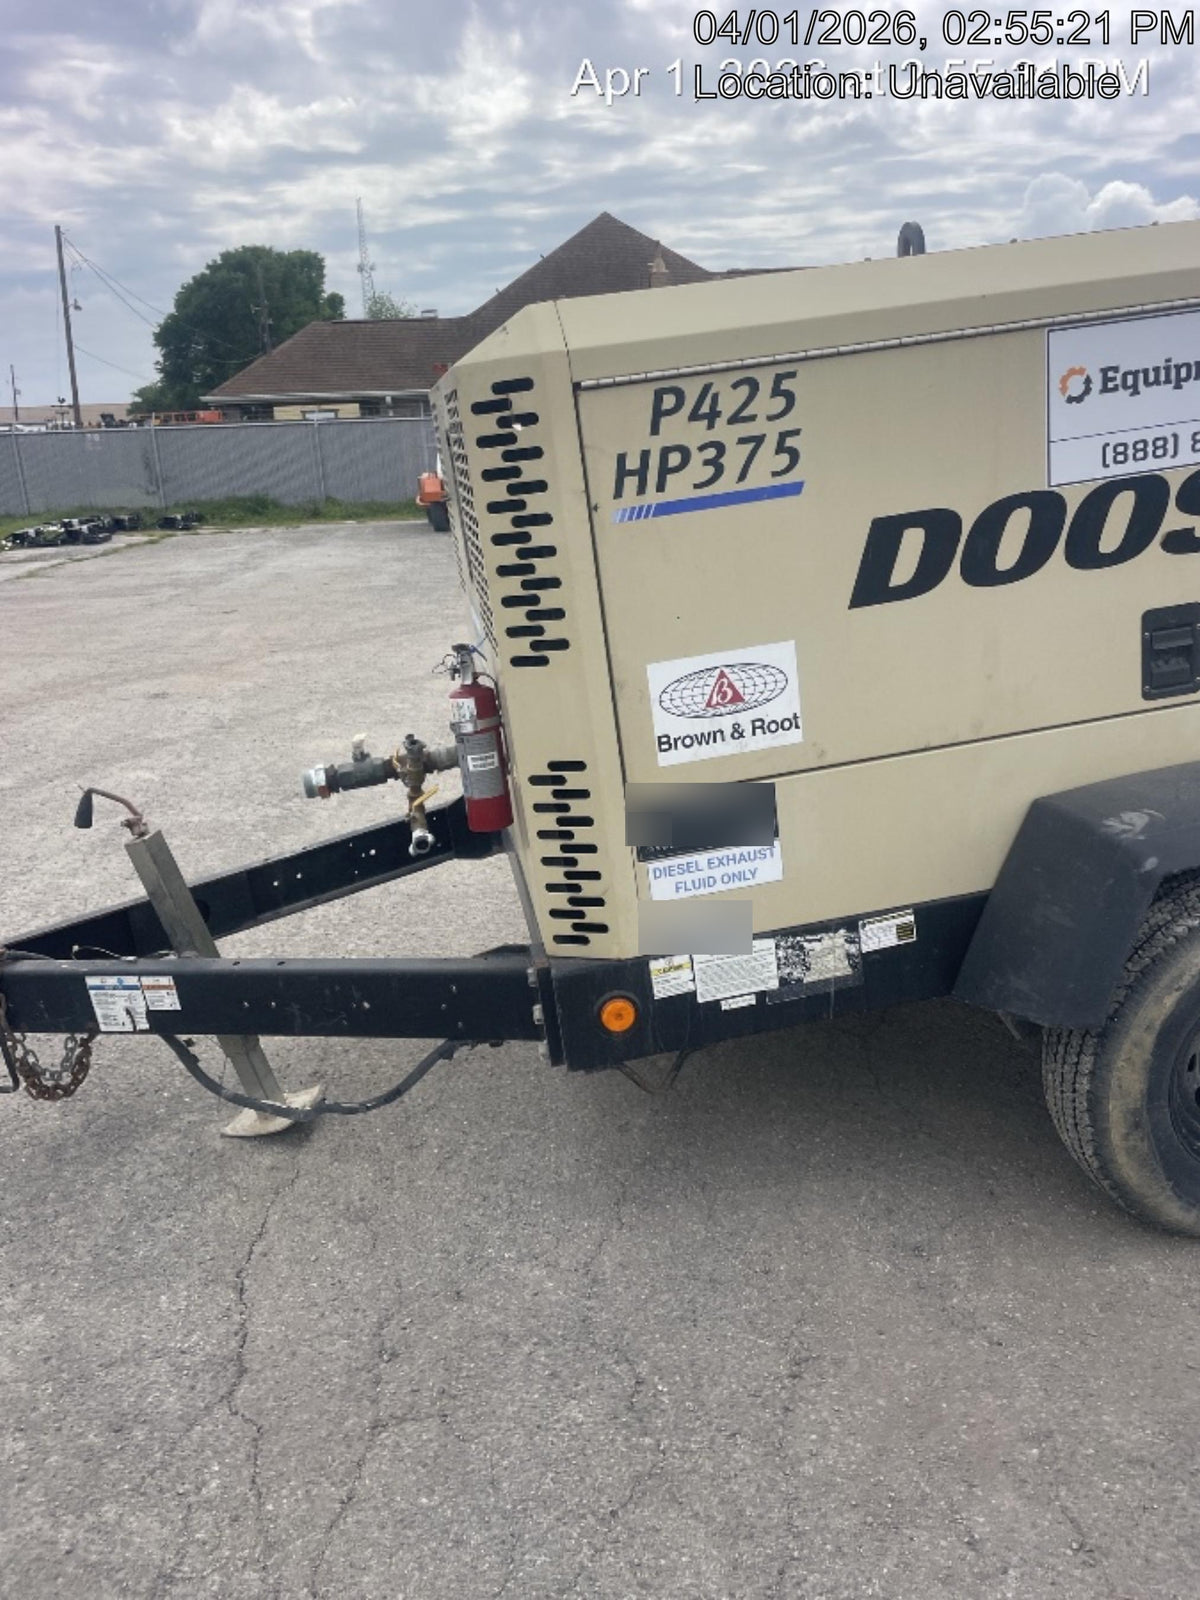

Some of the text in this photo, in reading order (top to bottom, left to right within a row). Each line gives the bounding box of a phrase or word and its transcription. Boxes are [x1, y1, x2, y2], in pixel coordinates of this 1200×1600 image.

[1099, 358, 1200, 397] Equip
[649, 371, 798, 436] P425
[613, 428, 802, 500] HP375
[1102, 433, 1180, 468] (888)
[657, 711, 801, 753] Brown & Root
[653, 859, 703, 881] DIESEL
[706, 847, 776, 870] EXHAUST
[675, 867, 759, 893] FLUID ONLY
